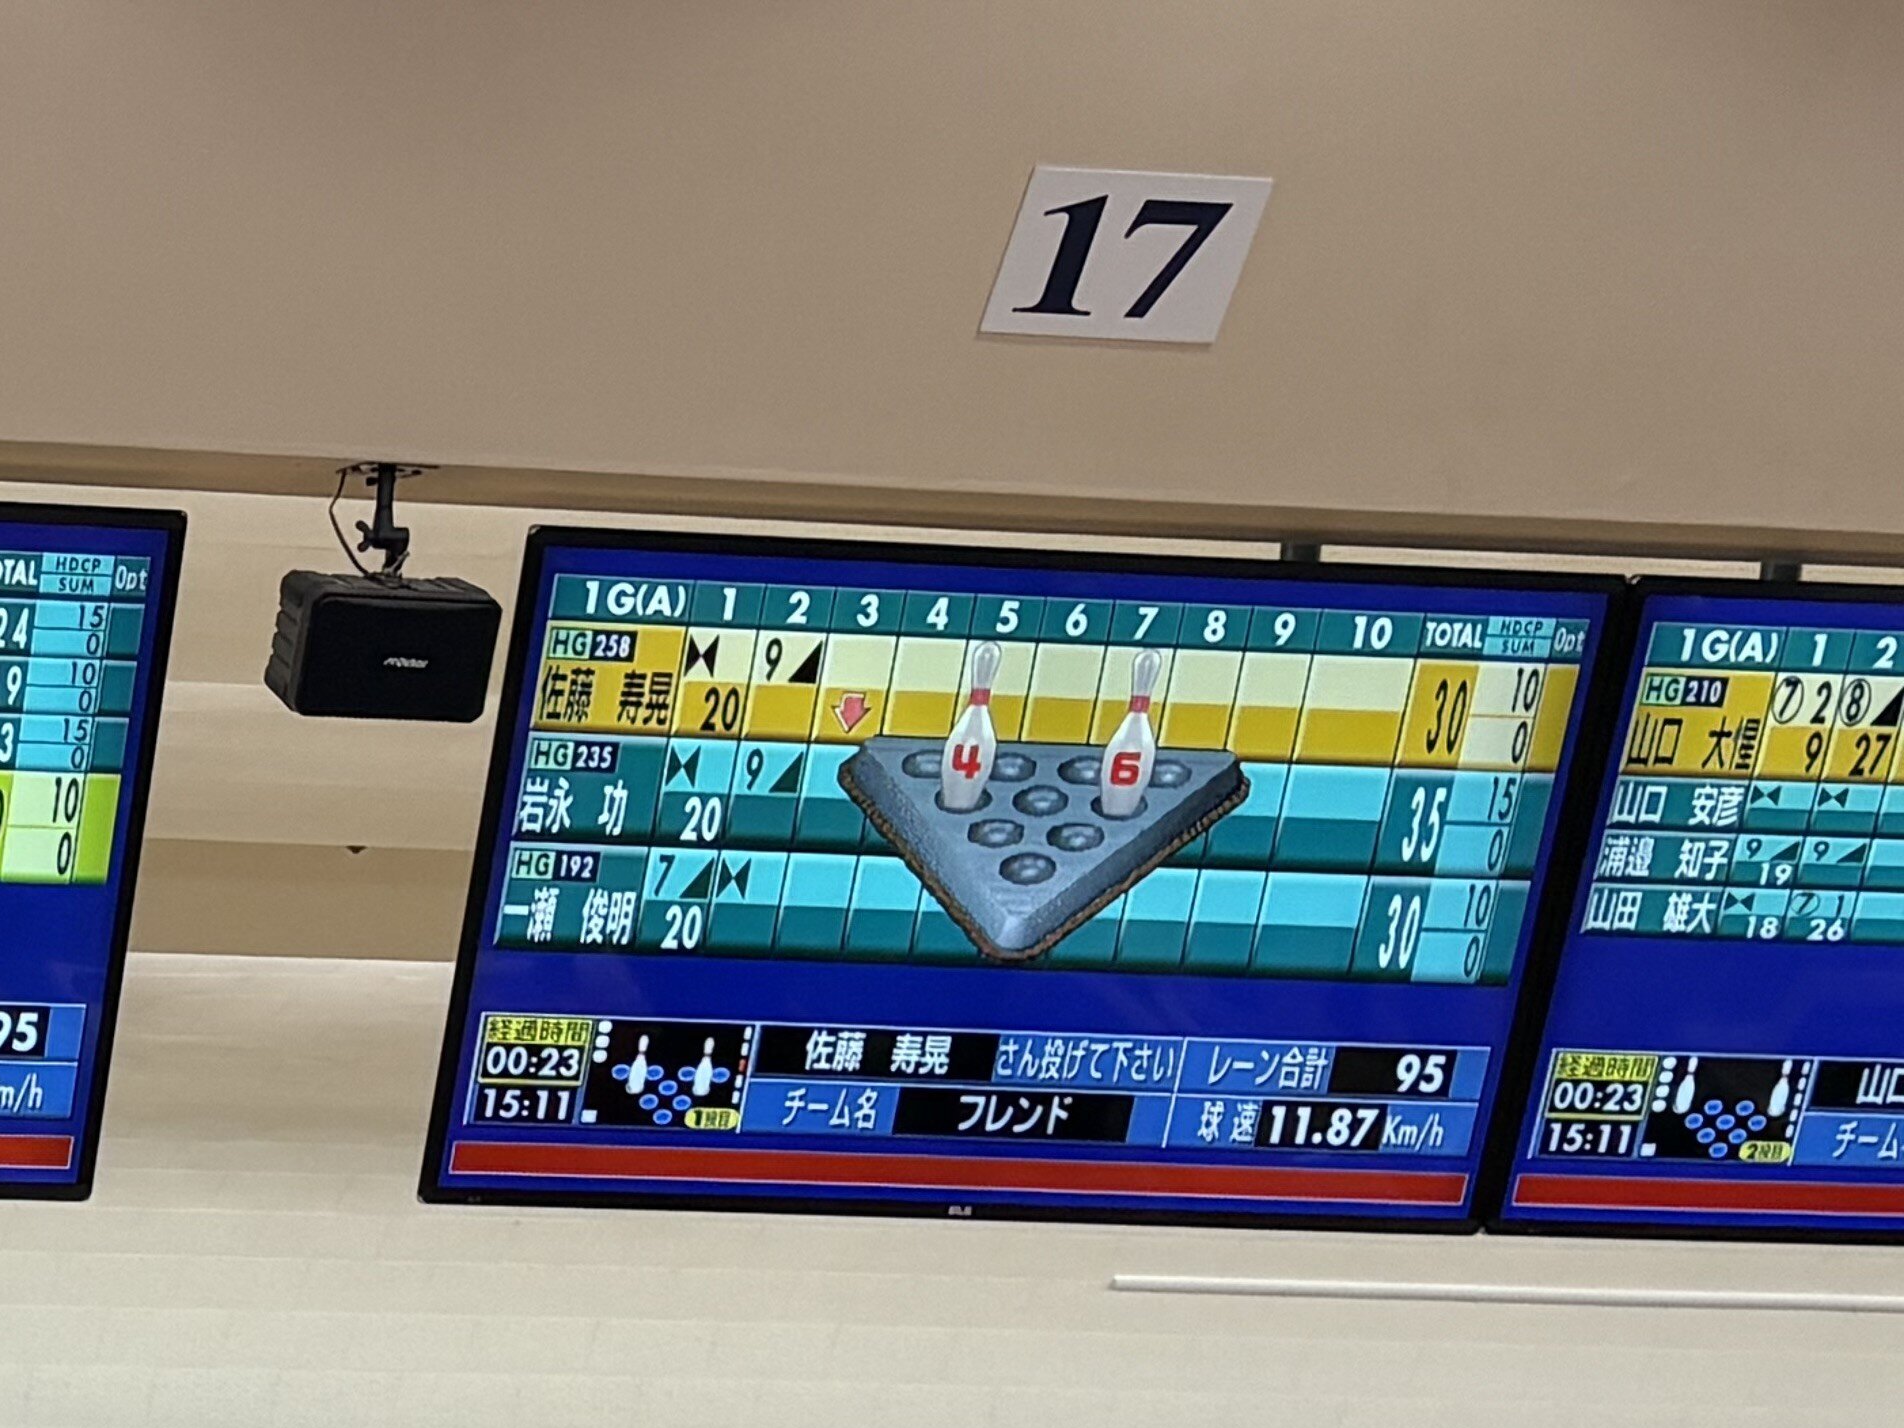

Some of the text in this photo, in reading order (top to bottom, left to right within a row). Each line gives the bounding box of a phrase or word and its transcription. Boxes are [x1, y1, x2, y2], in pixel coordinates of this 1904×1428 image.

[1012, 194, 1234, 319] 17
[541, 665, 595, 723] 佐藤
[952, 744, 981, 779] 4
[1626, 712, 1684, 766] 山口
[1109, 752, 1142, 786] 6
[520, 776, 629, 836] 岩永 功
[1612, 782, 1745, 827] 山口 安彦
[1674, 838, 1730, 881] 知子
[580, 888, 637, 945] 俊明
[1586, 890, 1643, 931] 山田
[486, 1045, 580, 1078] 00:23
[805, 1030, 1447, 1094] 佐藤 寿晃 さん投げて下さい レーン合計 95
[481, 1088, 571, 1121] 15:11
[782, 1088, 879, 1130] チーム名
[957, 1093, 1072, 1135] フレンド
[1269, 1105, 1381, 1147] 11.87
[1381, 1114, 1444, 1149] Km/h
